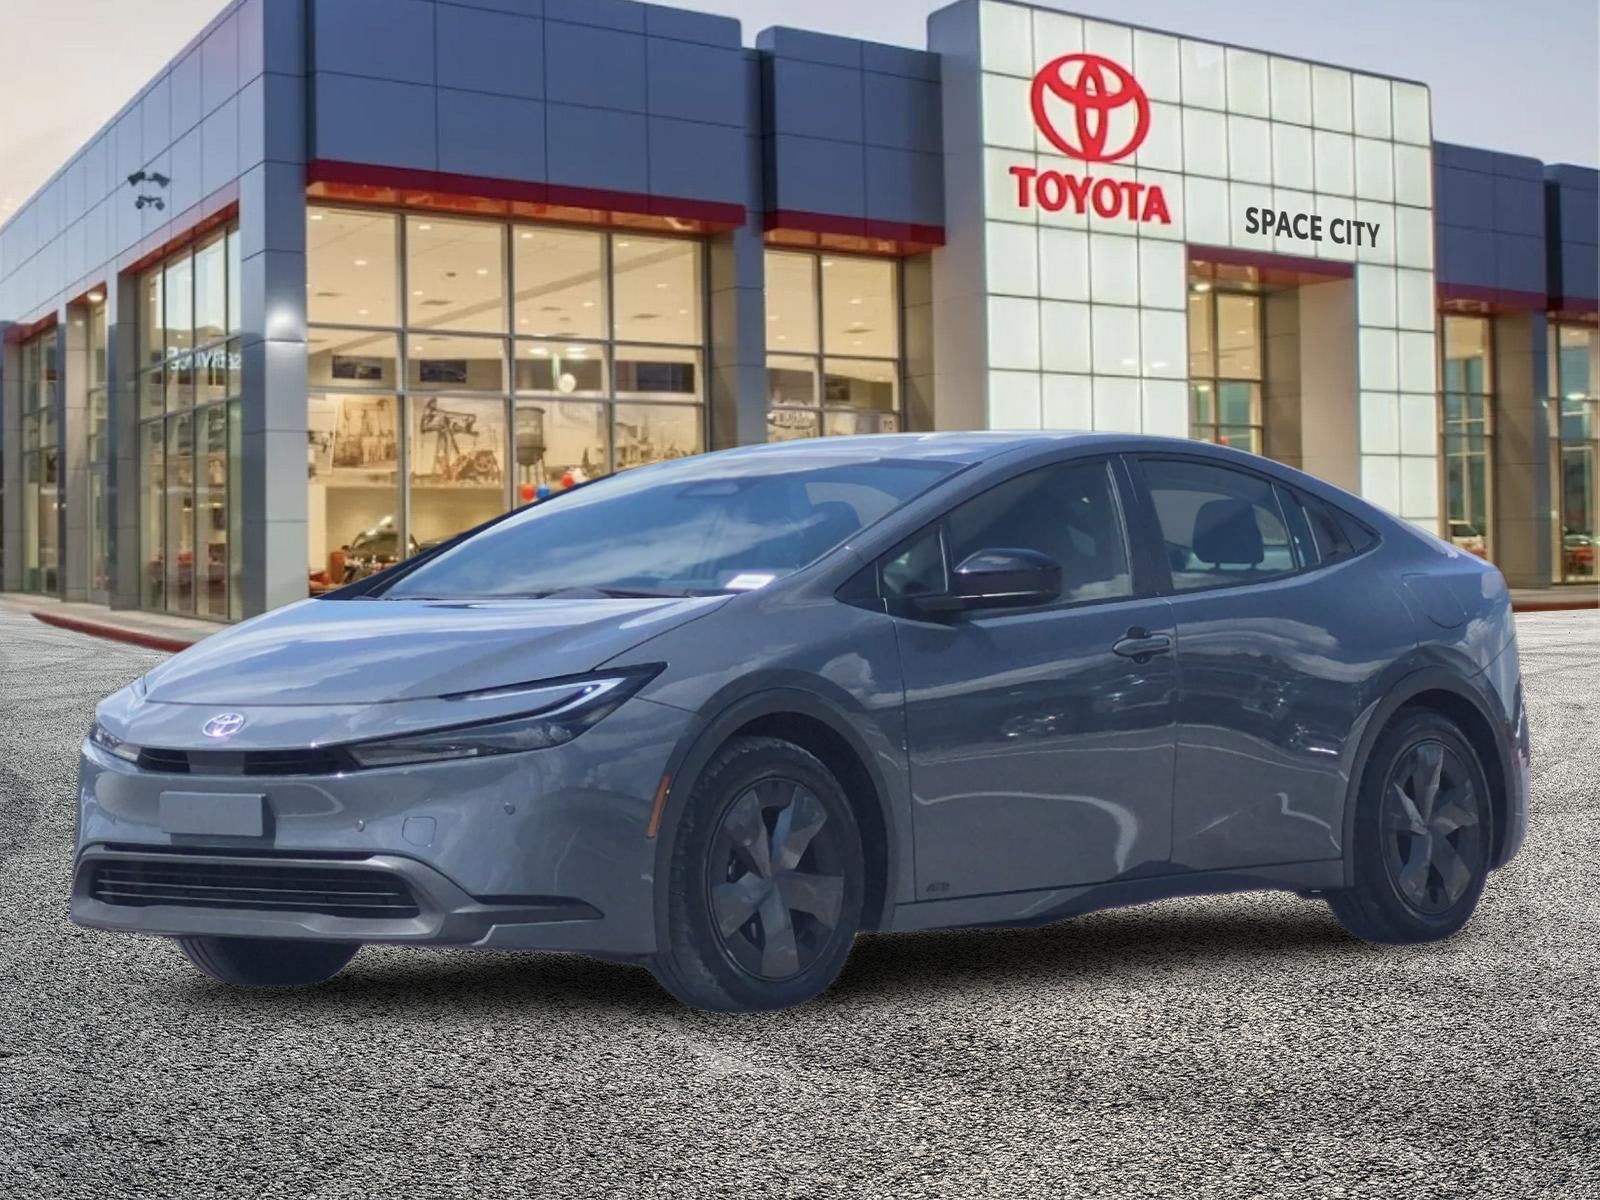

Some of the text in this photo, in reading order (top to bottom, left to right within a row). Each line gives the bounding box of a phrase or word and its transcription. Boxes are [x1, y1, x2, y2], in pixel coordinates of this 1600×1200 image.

[1009, 166, 1171, 224] TOYOTA
[1245, 206, 1380, 248] SPACE CITY
